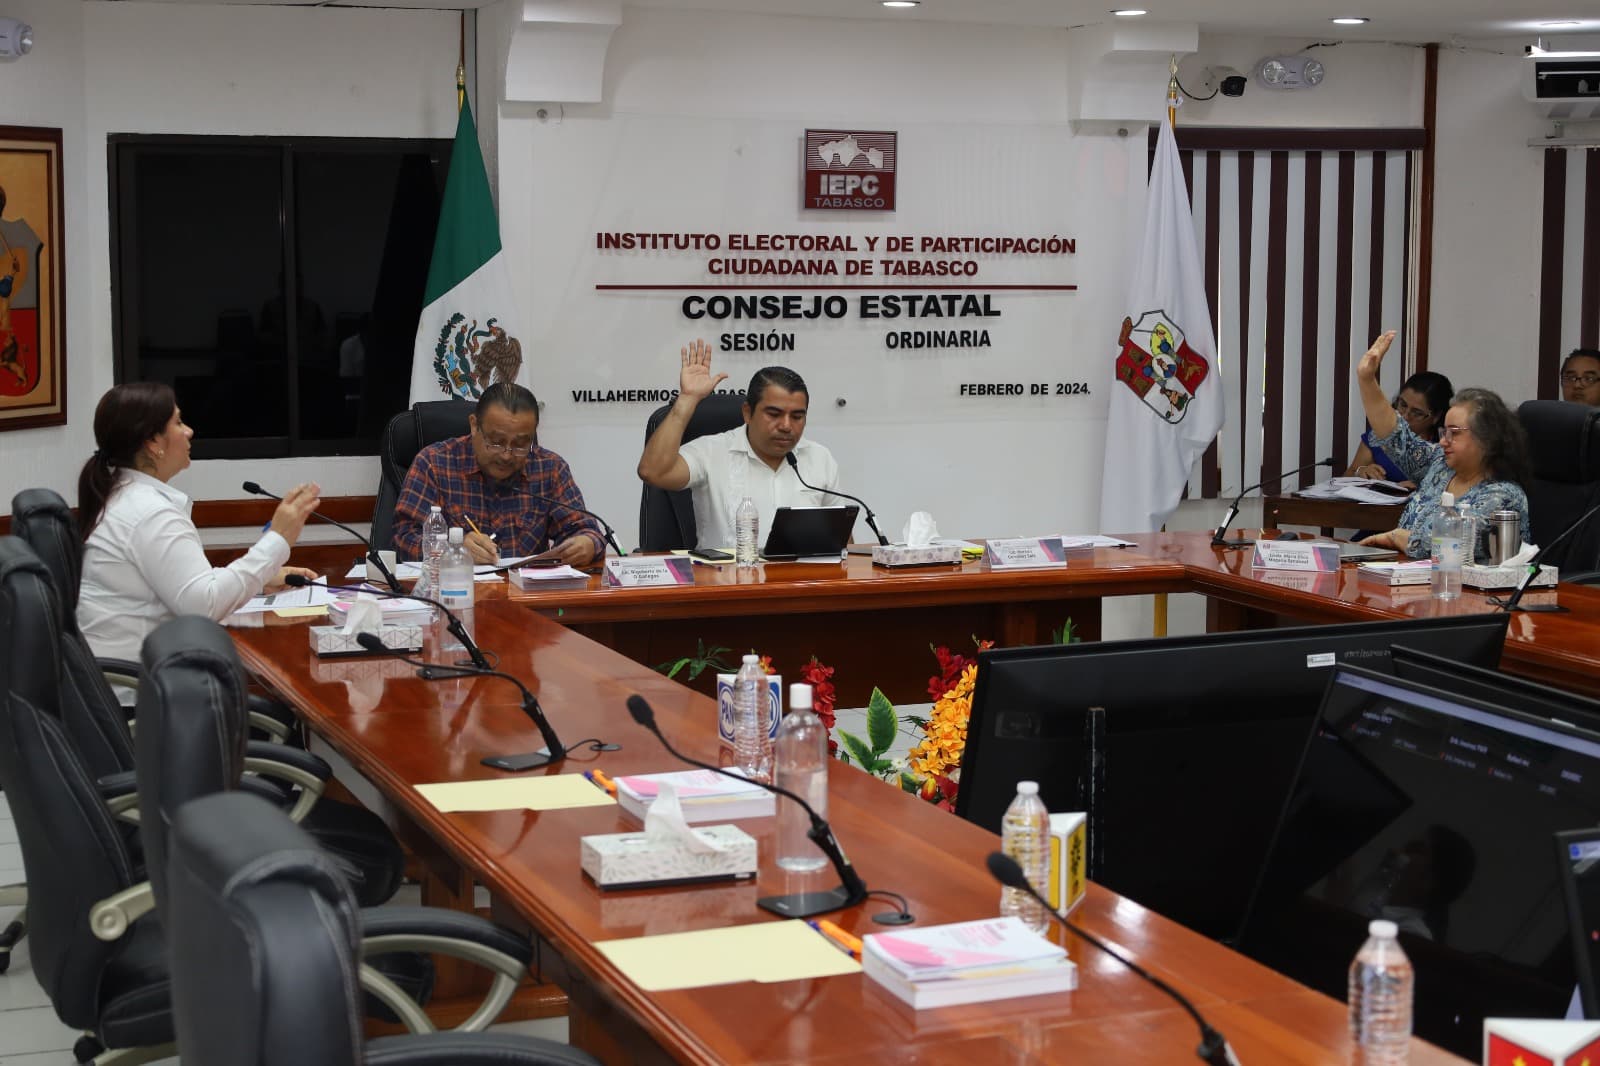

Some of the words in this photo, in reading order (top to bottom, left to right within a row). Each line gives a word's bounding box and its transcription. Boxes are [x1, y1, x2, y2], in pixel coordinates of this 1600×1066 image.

[820, 174, 880, 196] IEPC
[814, 197, 885, 208] TABASCO
[596, 232, 721, 251] INSTITUTO
[728, 234, 858, 252] ELECTORAL
[864, 236, 880, 252] Y
[886, 236, 914, 252] DE
[920, 234, 1076, 254] PARTICIPACIÓN
[707, 258, 839, 276] CIUDADANA
[845, 259, 874, 276] DE
[880, 260, 979, 277] TABASCO
[681, 295, 848, 320] CONSEJO
[859, 294, 1002, 319] ESTATAL
[719, 328, 795, 352] SESIÓN
[885, 329, 992, 350] ORDINARIA
[571, 389, 680, 404] VILLAHERMOS
[959, 383, 1024, 396] FEBRERO
[1030, 383, 1049, 396] DE
[1055, 382, 1091, 396] 2024.
